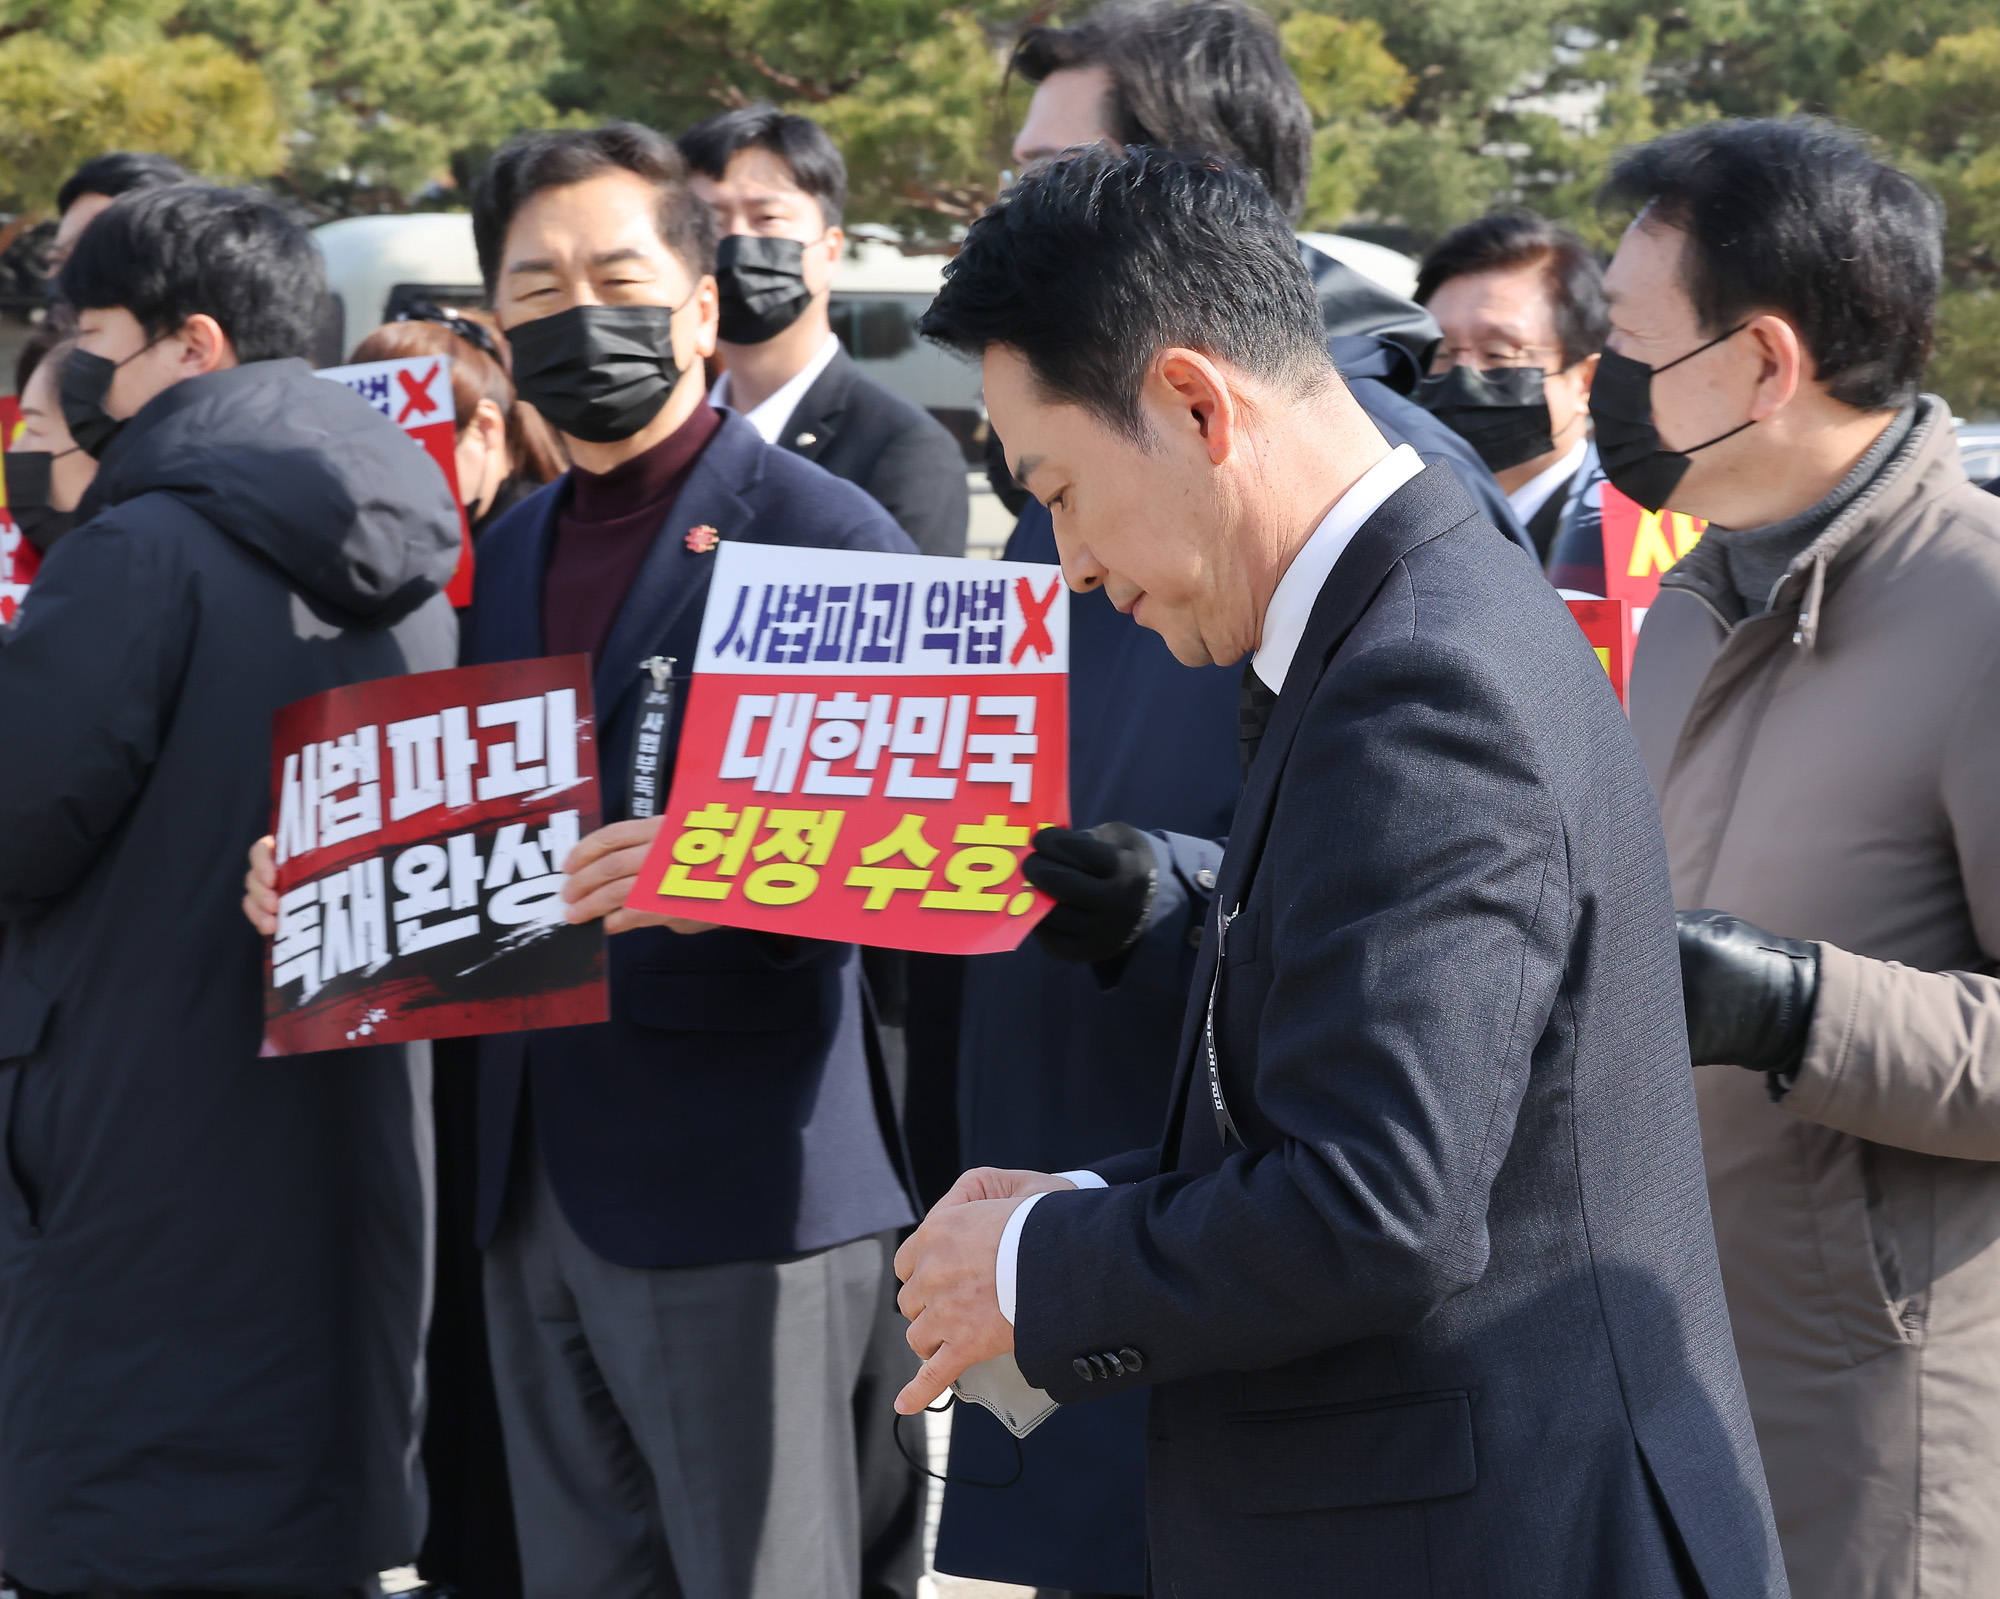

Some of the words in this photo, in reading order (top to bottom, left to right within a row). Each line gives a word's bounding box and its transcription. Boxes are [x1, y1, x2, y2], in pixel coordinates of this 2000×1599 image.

[714, 582, 913, 664] 사법파괴
[922, 578, 1006, 665] 악법
[275, 724, 382, 866] 사법
[386, 688, 579, 821] 파괴
[718, 691, 1038, 803] 대한민국
[272, 857, 391, 1004] 독재
[393, 809, 581, 957] 완성
[657, 803, 846, 906] 헌정
